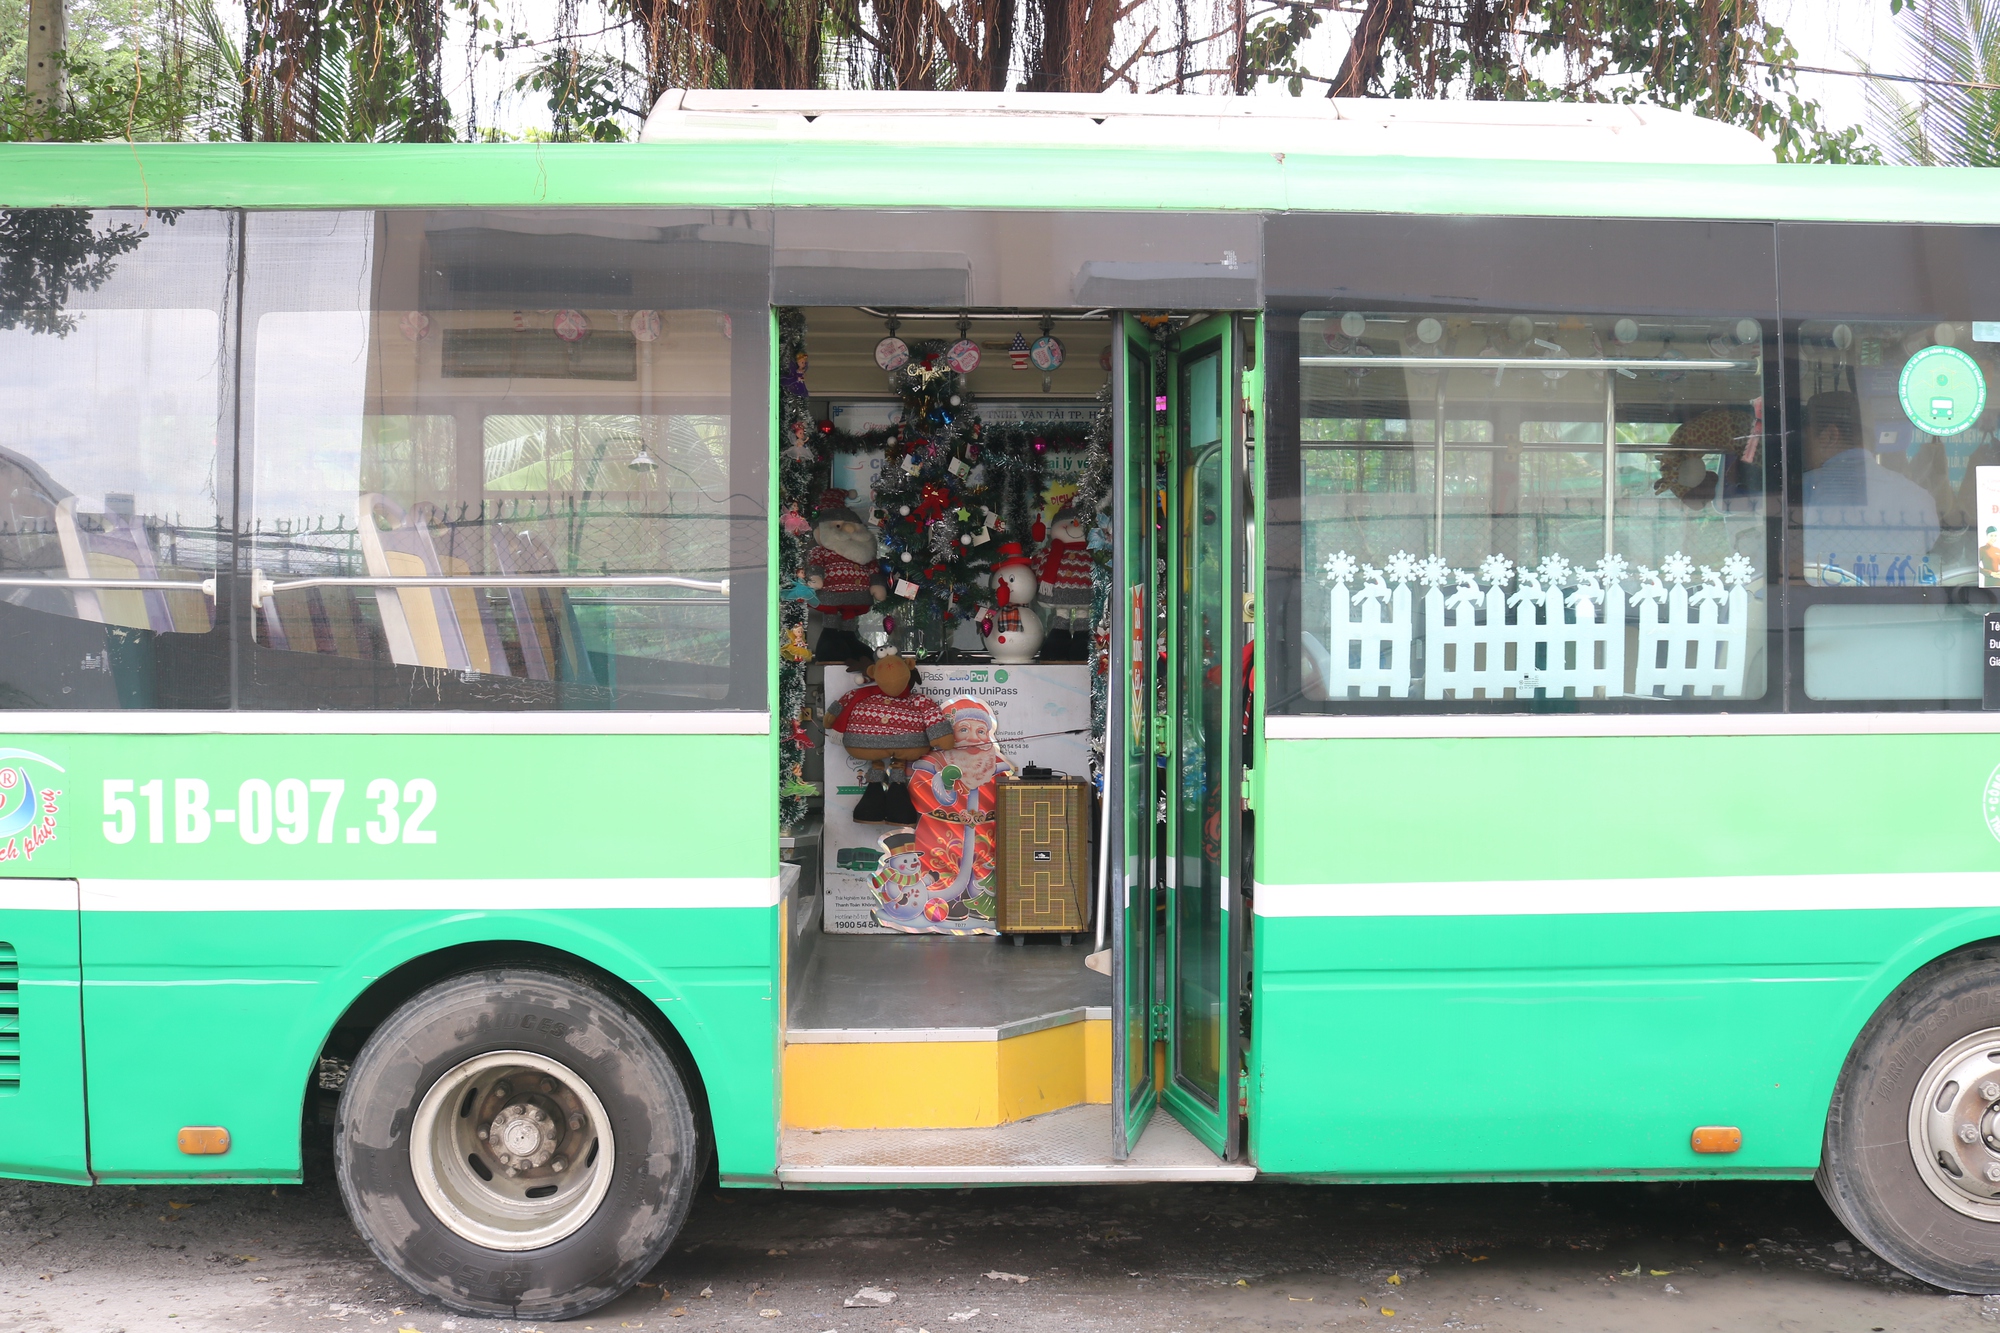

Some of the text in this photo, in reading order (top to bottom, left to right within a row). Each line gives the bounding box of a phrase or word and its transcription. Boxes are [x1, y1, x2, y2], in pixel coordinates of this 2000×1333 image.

[988, 410, 1016, 419] TNHH
[1022, 410, 1042, 422] VẬN
[1048, 408, 1064, 419] TẢI
[1068, 411, 1084, 419] TP.
[1048, 457, 1059, 470] ại
[1064, 456, 1072, 470] lý
[921, 672, 944, 680] iPass
[920, 687, 950, 697] Thông
[952, 686, 976, 695] Minh
[979, 687, 1018, 695] UniPass
[102, 777, 437, 845] 51B-097.32
[24, 816, 57, 860] phục
[41, 787, 62, 813] vụ
[455, 1013, 619, 1074] BRIDGESTONE
